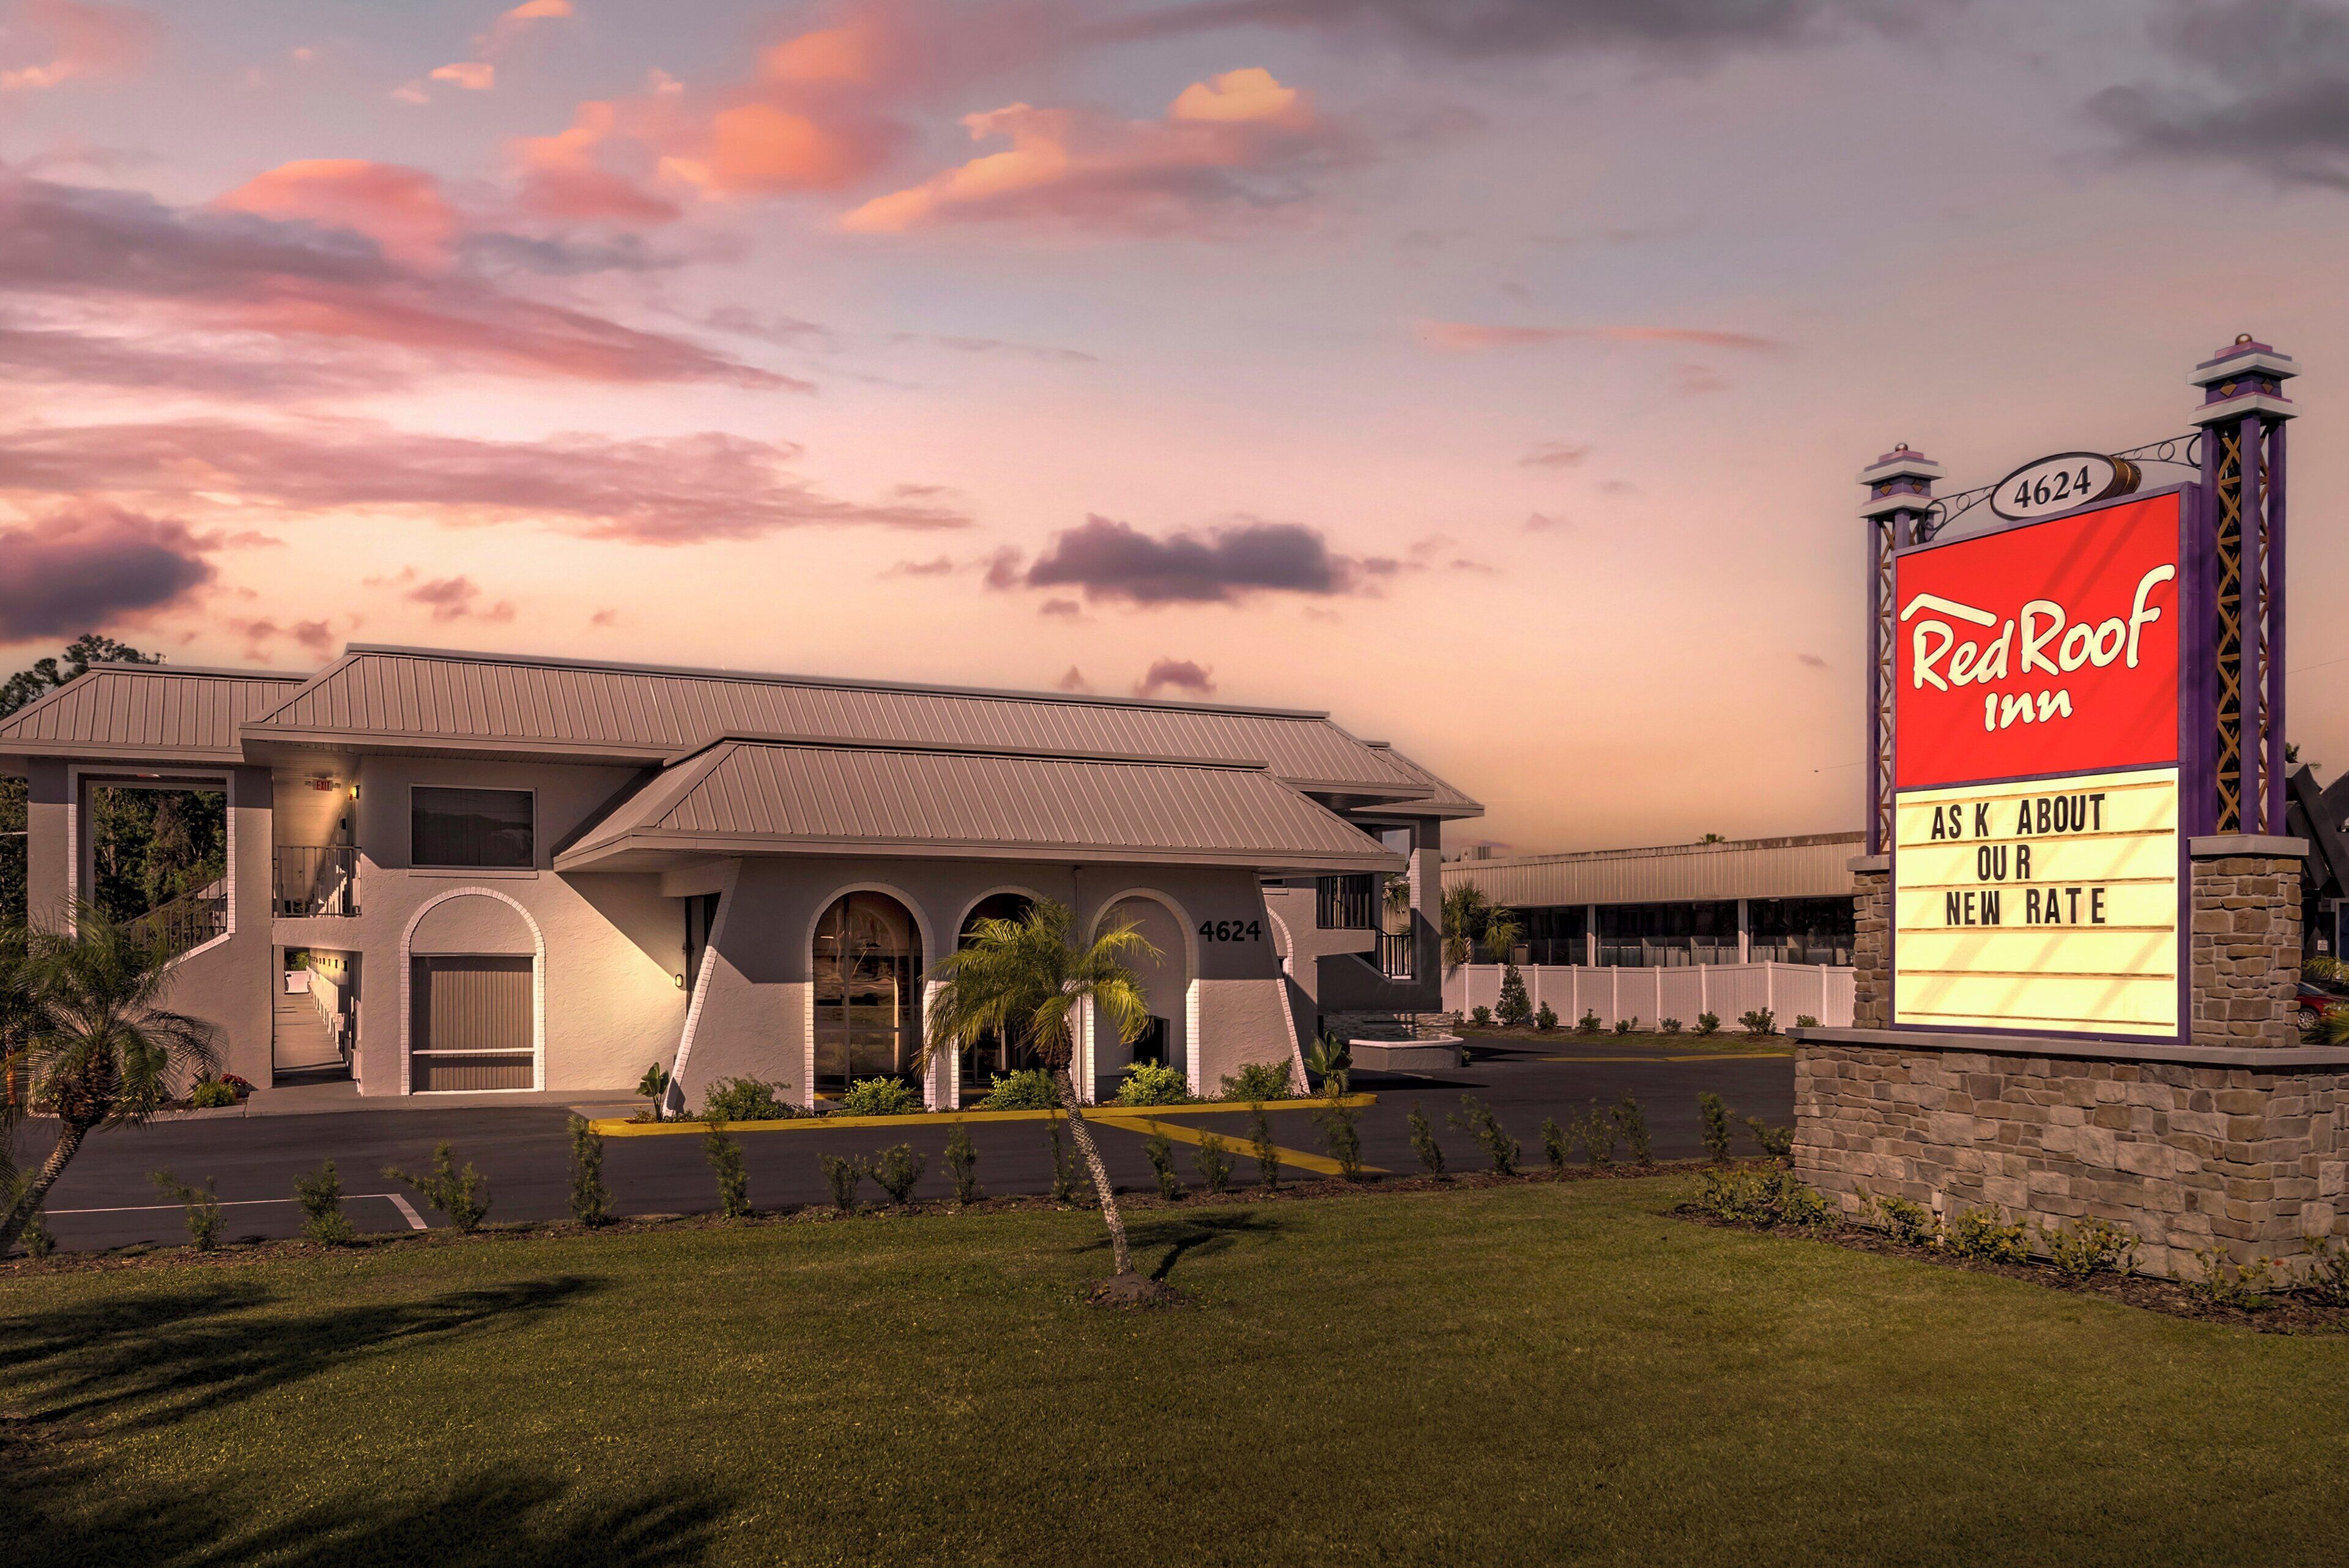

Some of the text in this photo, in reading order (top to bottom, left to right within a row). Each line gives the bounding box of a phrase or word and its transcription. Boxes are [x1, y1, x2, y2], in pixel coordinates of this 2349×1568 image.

[2014, 465, 2091, 508] 4624
[1913, 564, 2175, 692] Red Roof
[316, 780, 330, 791] EXIT
[1931, 793, 2106, 840] ASK ABOUT
[1978, 844, 2030, 881] OUR
[1946, 887, 2106, 926] NEW RATE
[1199, 920, 1261, 942] 4624
